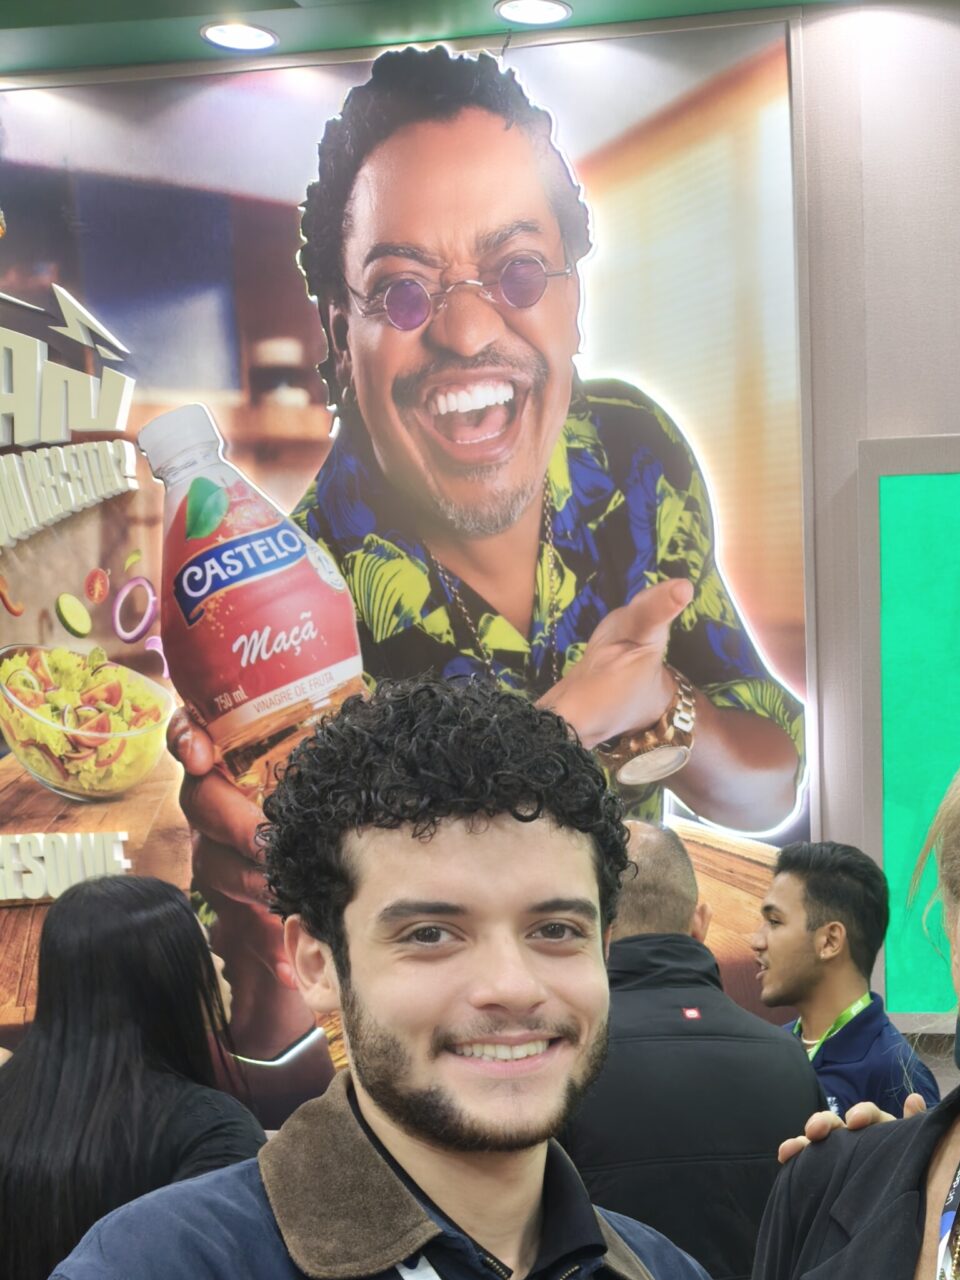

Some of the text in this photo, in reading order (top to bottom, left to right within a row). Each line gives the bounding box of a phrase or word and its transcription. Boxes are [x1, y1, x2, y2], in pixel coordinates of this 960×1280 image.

[183, 529, 301, 598] CASTELO
[232, 611, 318, 667] Maçã
[214, 693, 231, 712] 750
[253, 671, 334, 714] VINAGRE DE FRUTA
[0, 831, 132, 899] ESOLVE
